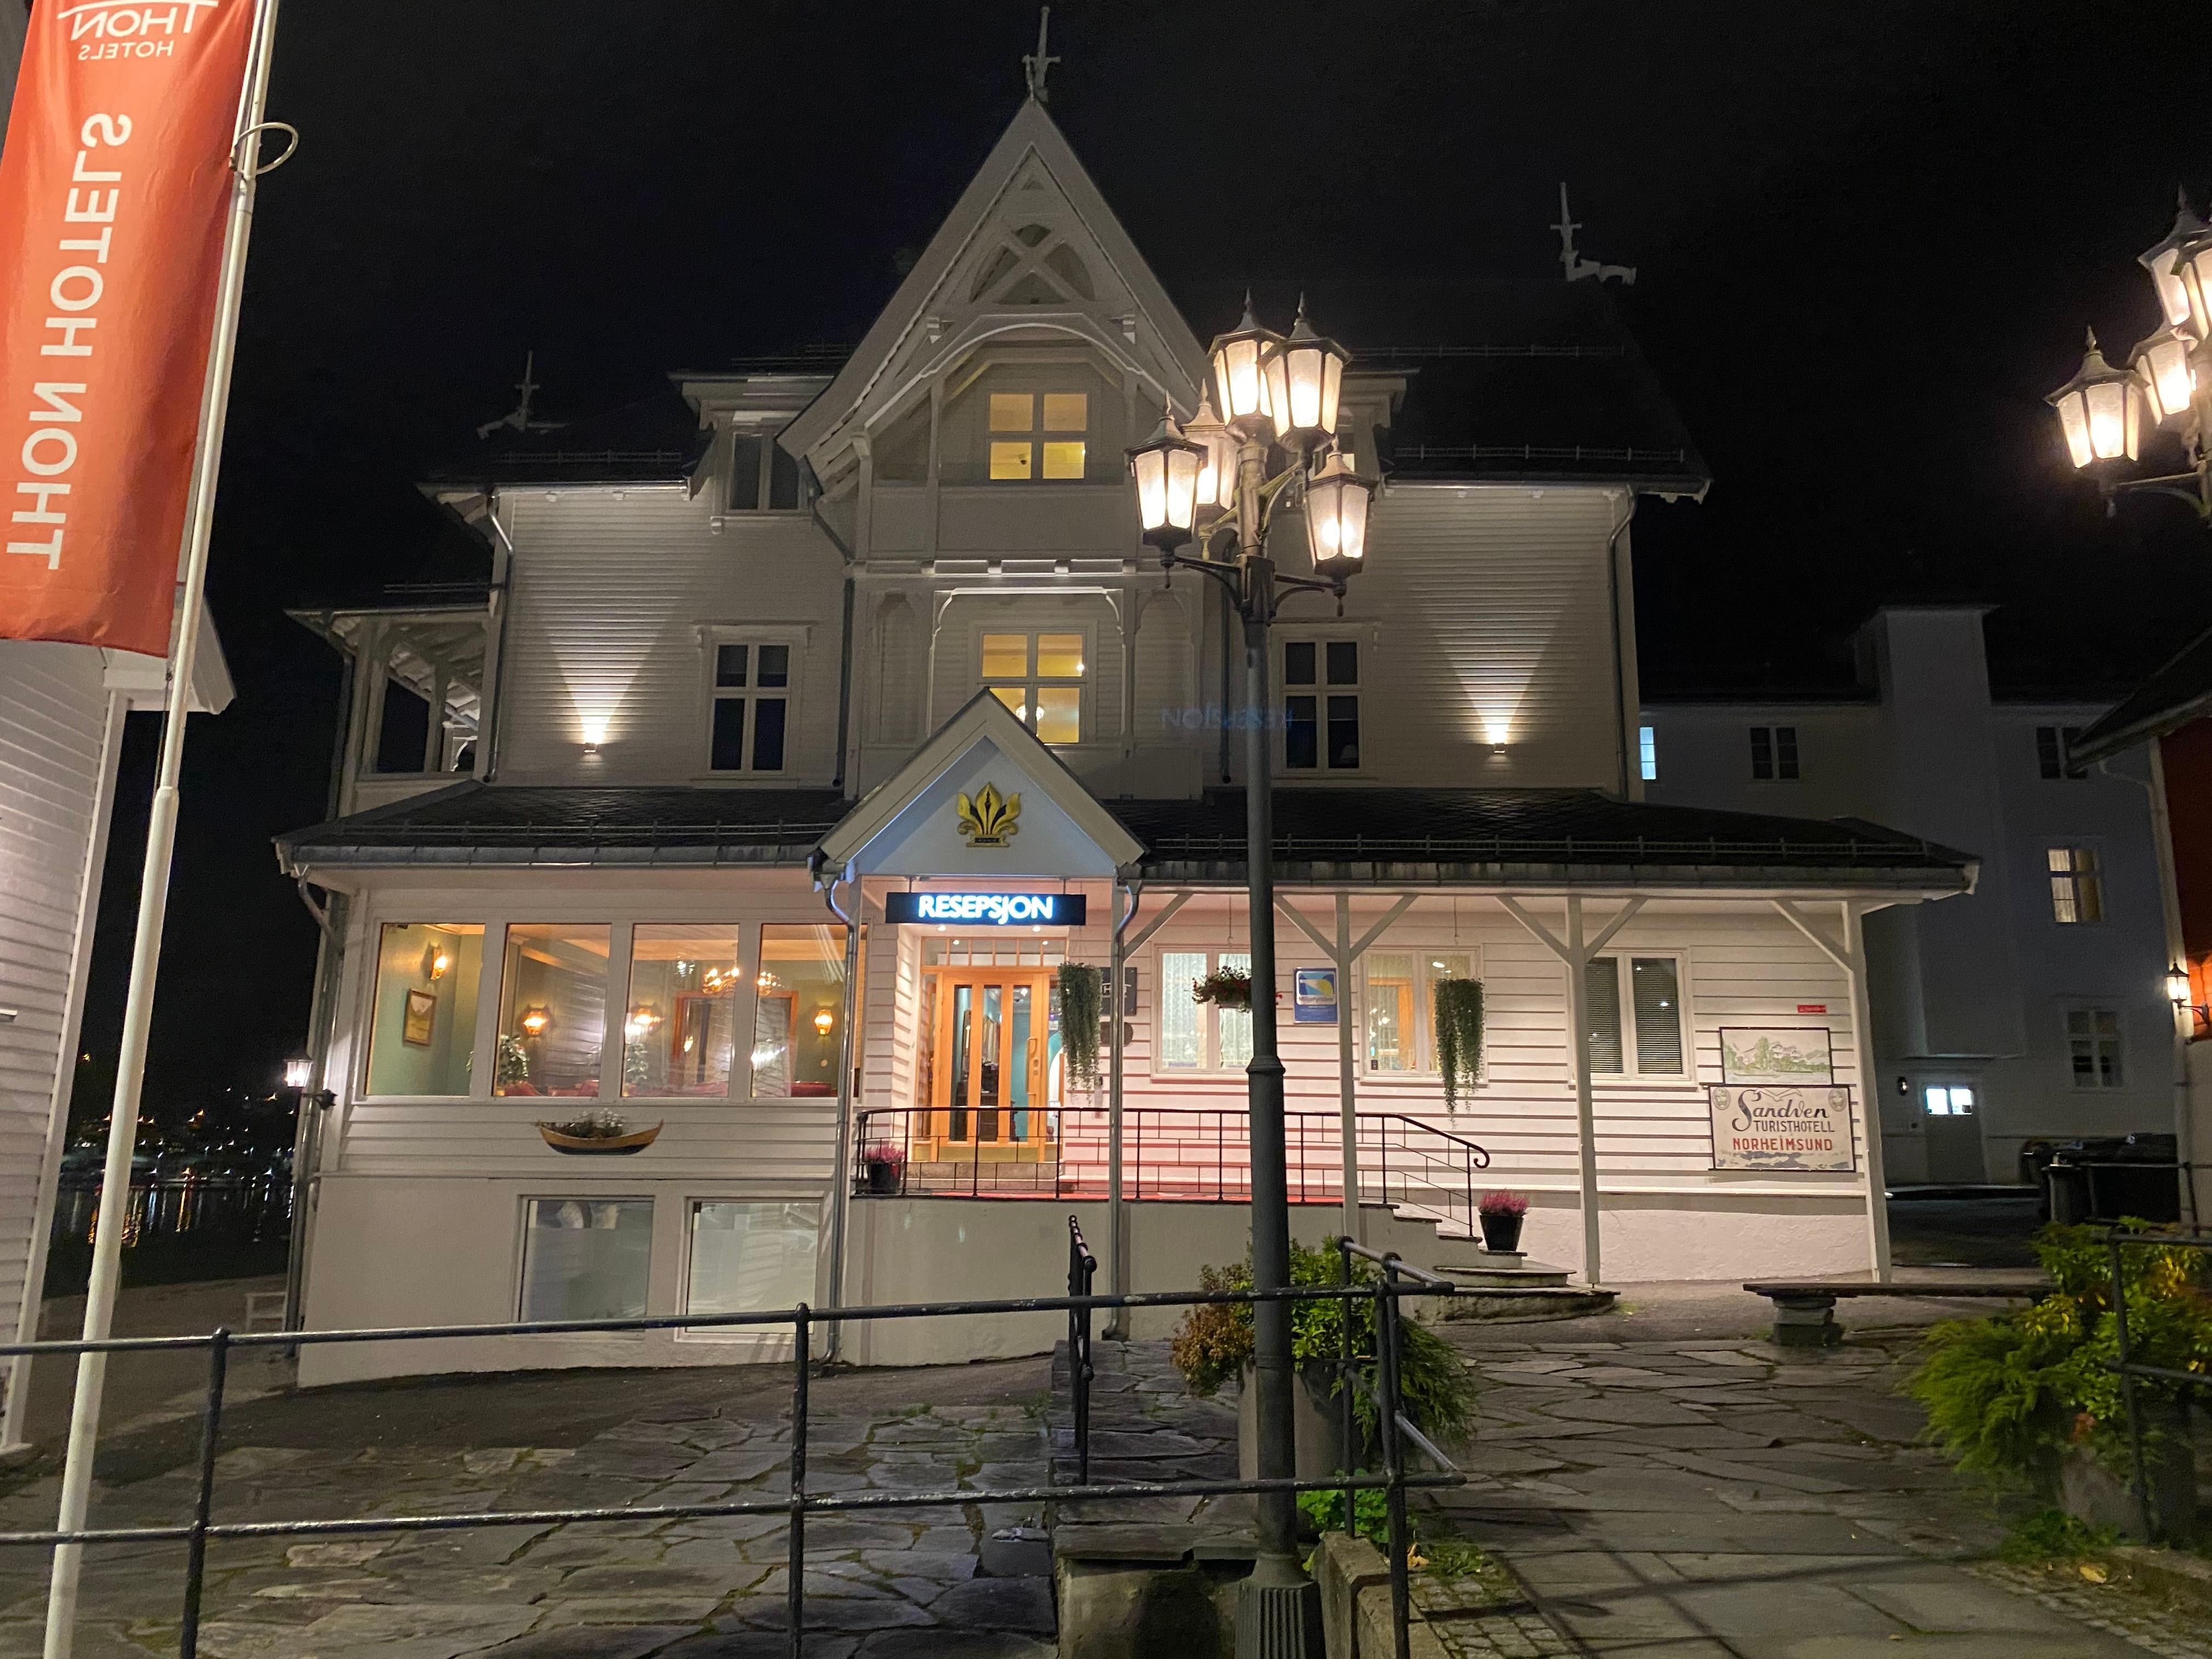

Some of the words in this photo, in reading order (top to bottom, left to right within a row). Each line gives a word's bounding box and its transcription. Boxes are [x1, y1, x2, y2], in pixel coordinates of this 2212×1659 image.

[918, 895, 1053, 926] RESEPSJON
[1731, 1089, 1830, 1132] Sandven
[1753, 1120, 1835, 1133] TURISTHOTELL
[1733, 1136, 1833, 1151] NORHEIMSUND
